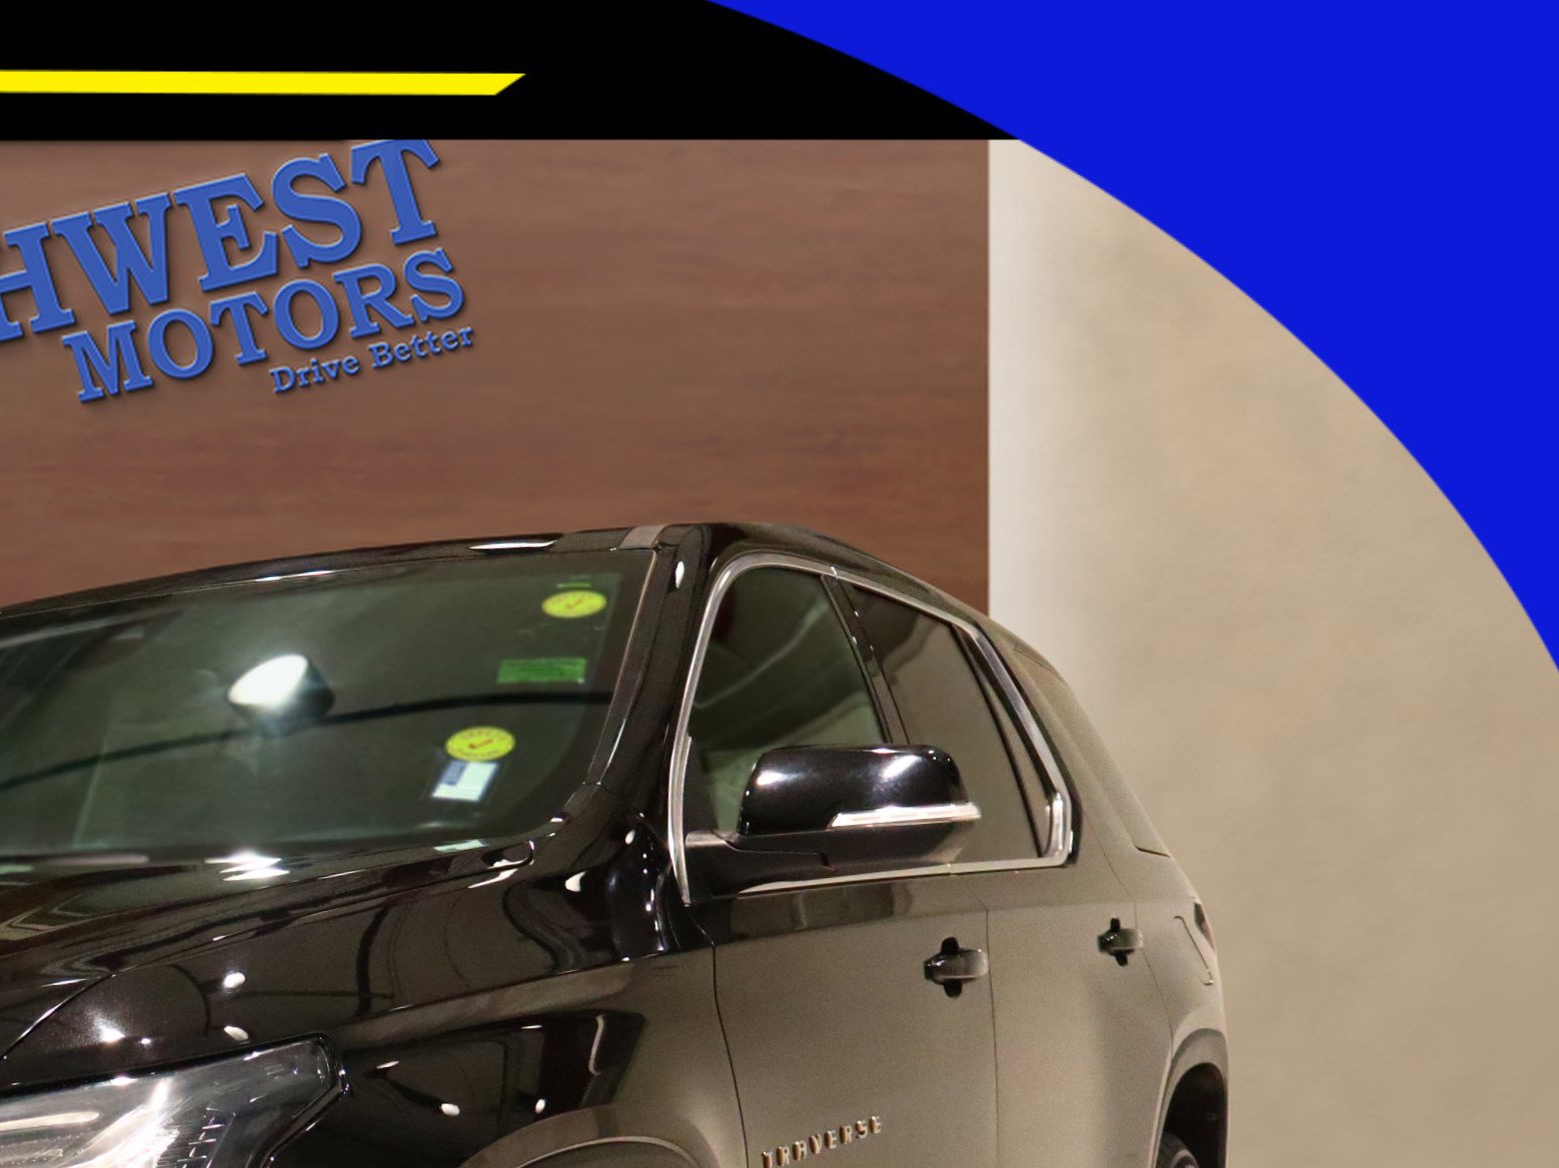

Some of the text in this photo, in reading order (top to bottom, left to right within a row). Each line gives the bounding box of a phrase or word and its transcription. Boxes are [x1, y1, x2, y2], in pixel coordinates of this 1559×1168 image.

[62, 248, 465, 402] MOTORS
[270, 324, 474, 393] Drive Better
